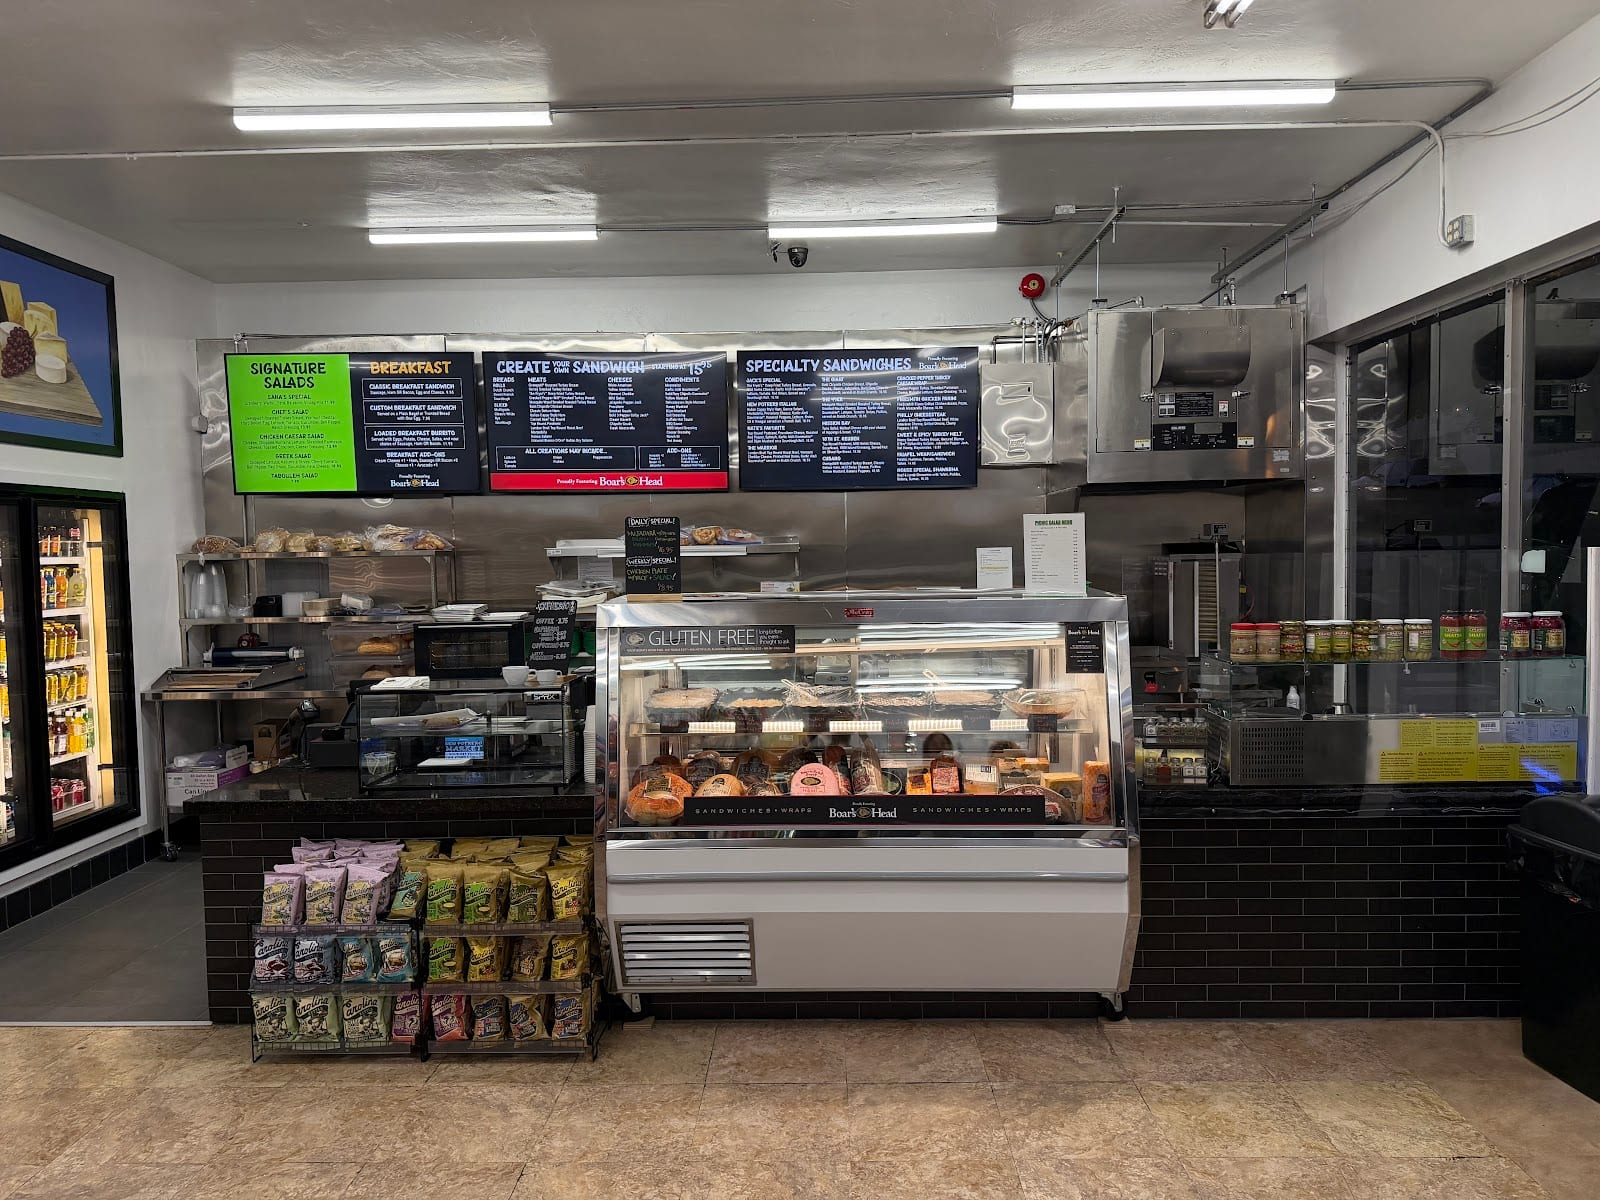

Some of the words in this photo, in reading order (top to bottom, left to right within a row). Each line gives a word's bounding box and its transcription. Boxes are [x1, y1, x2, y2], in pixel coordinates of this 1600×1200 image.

[251, 363, 326, 374] SIGNATURE
[369, 361, 451, 374] BREAKFAST
[497, 361, 551, 373] CREATE
[573, 361, 645, 373] SANDWICH
[746, 359, 820, 373] SPECIALTY
[823, 357, 911, 371] SANDWICHES
[264, 377, 314, 388] SALADS
[421, 479, 439, 487] Head
[600, 477, 625, 486] Boar's
[639, 476, 662, 485] Head
[649, 629, 711, 645] GLUTEN
[718, 629, 756, 645] FREE
[829, 807, 856, 818] Boar's
[871, 807, 897, 818] Head
